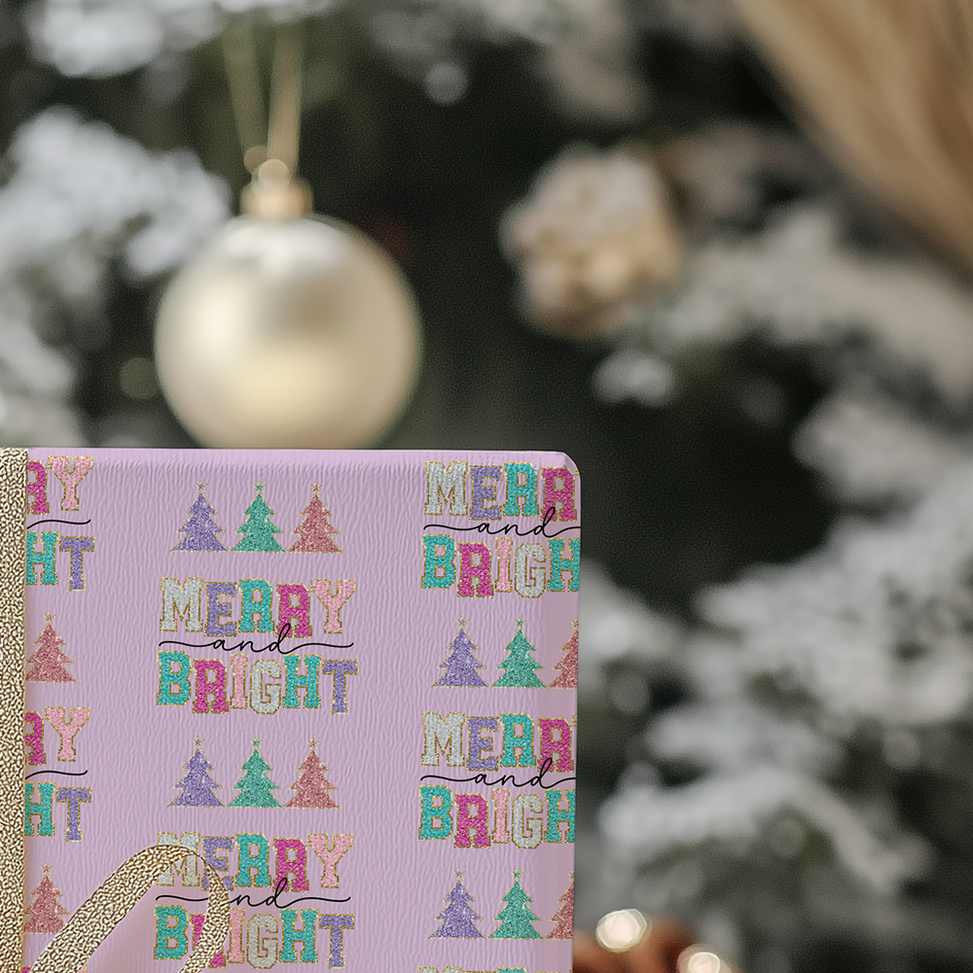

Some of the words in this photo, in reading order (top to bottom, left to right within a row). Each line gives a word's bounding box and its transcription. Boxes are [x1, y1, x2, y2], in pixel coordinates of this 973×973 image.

[424, 461, 580, 522] MERR
[421, 534, 580, 598] BRIGH
[159, 577, 357, 638] MERRY
[156, 650, 358, 715] BRIGHT
[421, 712, 577, 772] MERR
[418, 785, 576, 849] BRIGH
[157, 832, 353, 892] MERRY
